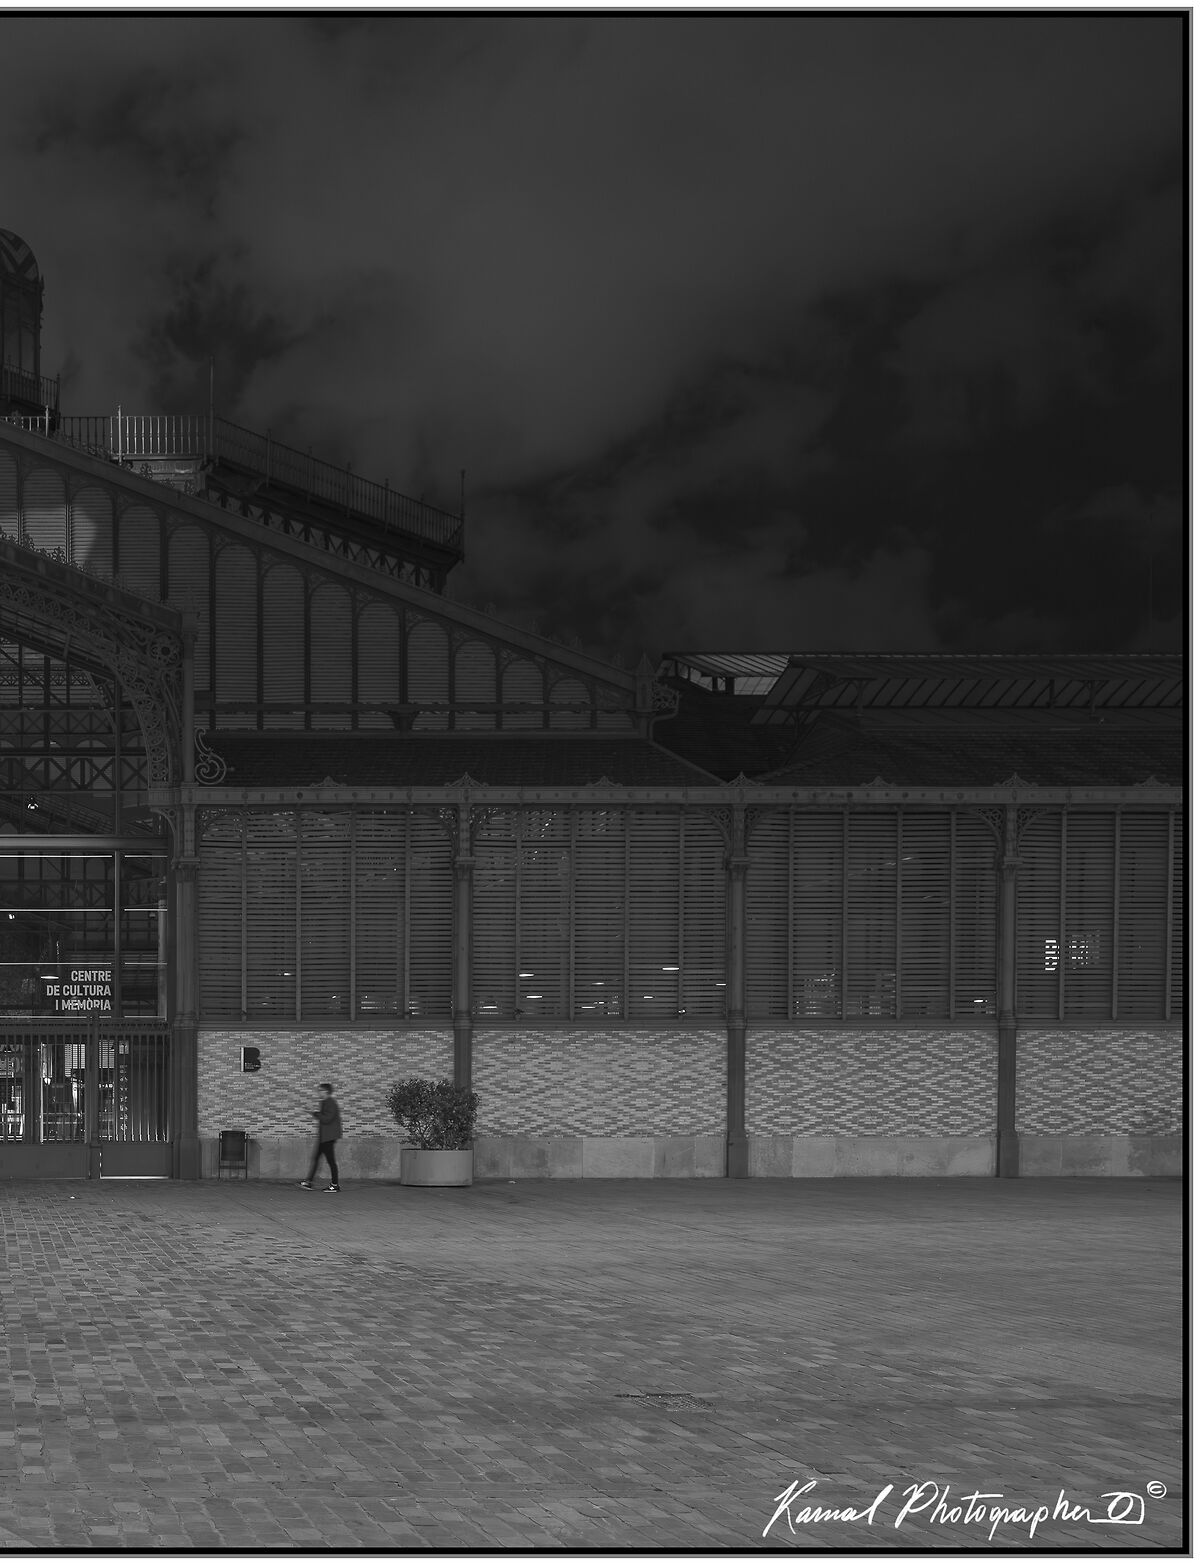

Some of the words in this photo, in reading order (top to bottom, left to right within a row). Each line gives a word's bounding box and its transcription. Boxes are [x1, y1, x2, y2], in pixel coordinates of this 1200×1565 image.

[70, 970, 112, 982] CENTRE
[46, 985, 61, 996] DE
[62, 984, 112, 996] CULTURA
[55, 999, 59, 1011] I
[61, 997, 112, 1011] MEMÒRIA
